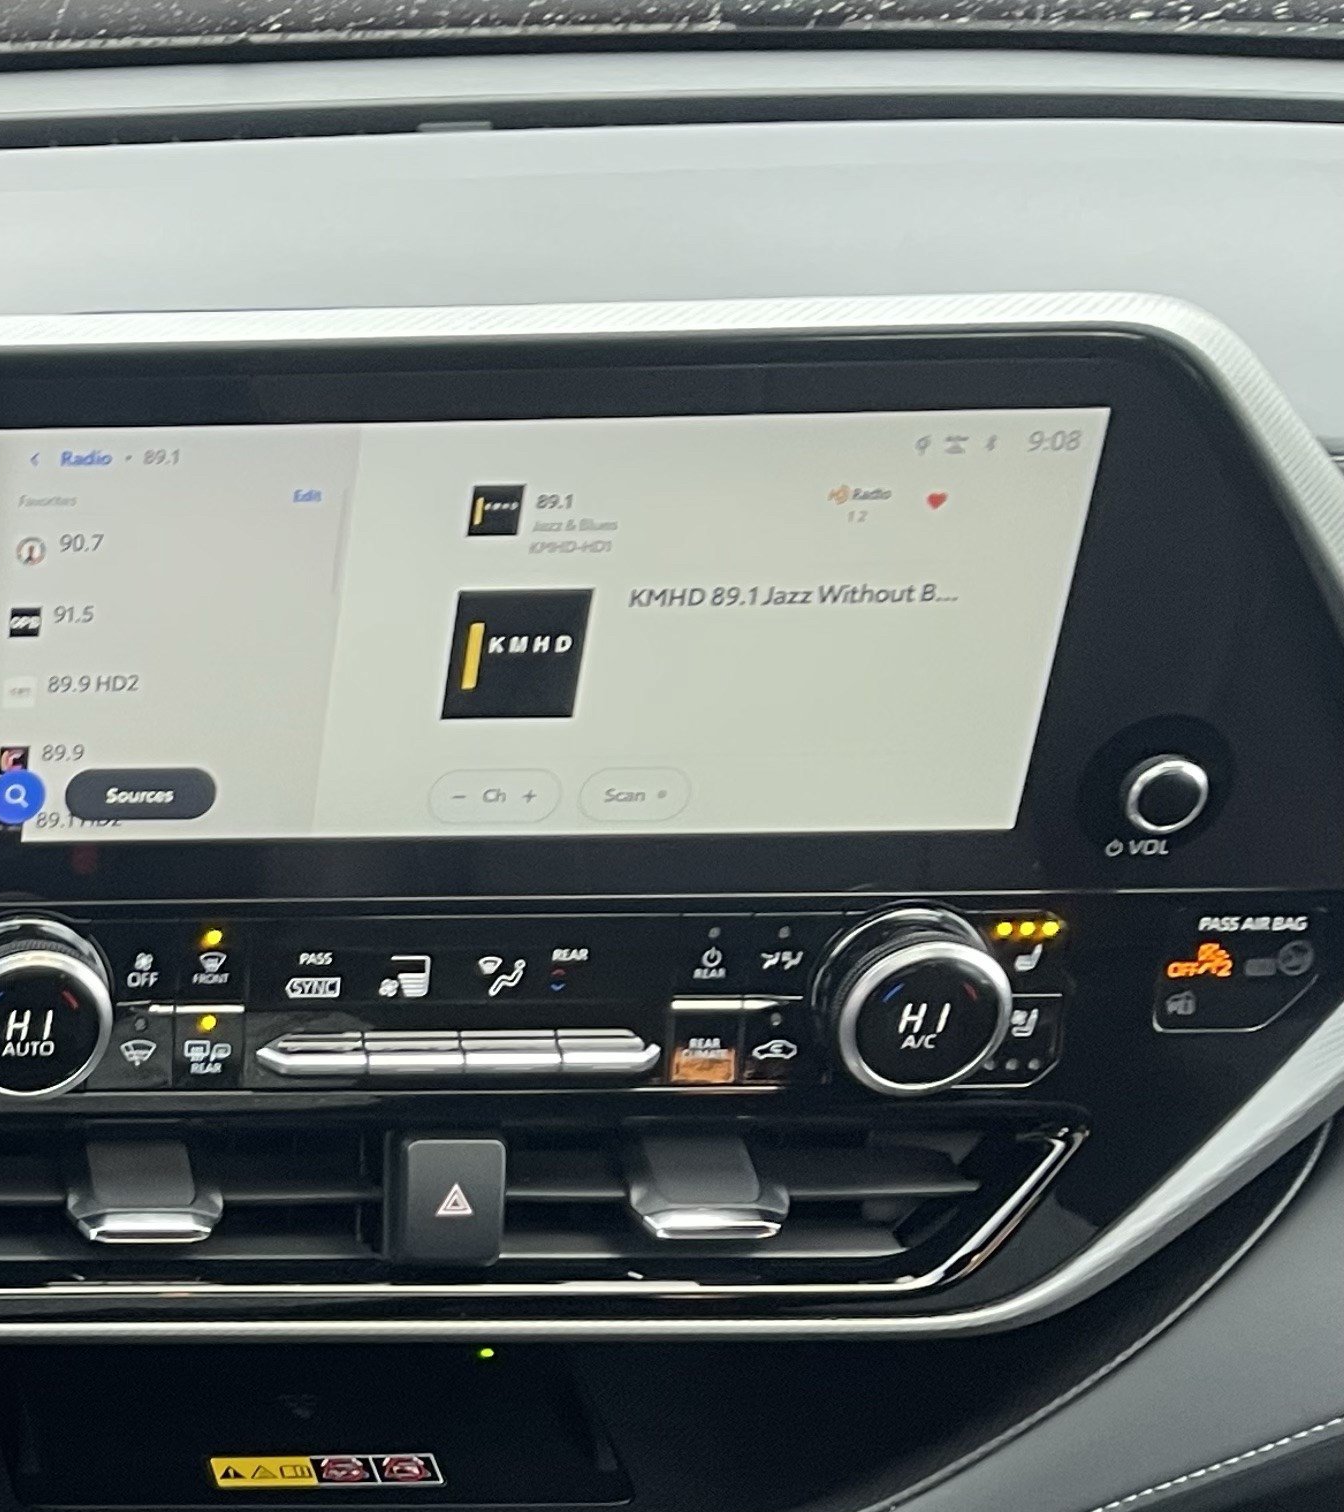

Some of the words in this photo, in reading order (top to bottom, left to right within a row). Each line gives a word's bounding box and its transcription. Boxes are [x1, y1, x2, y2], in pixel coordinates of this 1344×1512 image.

[1027, 430, 1082, 452] 9:08
[60, 451, 113, 467] Radio
[143, 449, 180, 466] 89.1
[293, 489, 322, 504] Edit
[536, 494, 573, 510] 89.1
[59, 534, 104, 553] 90.7
[629, 587, 706, 608] KMHD
[712, 586, 759, 607] 89.1
[761, 585, 813, 606] Jazz
[818, 583, 916, 605] Without
[53, 604, 95, 624] 91.5
[488, 635, 573, 654] KMHD
[47, 674, 92, 693] 89.9
[95, 674, 140, 692] HD2
[41, 743, 85, 762] 89.9
[105, 787, 174, 805] Sources
[482, 788, 507, 803] Ch
[604, 788, 646, 803] Scan
[1129, 839, 1169, 855] VOL
[1198, 916, 1241, 932] PASS
[1240, 916, 1271, 931] AIR
[1272, 916, 1308, 931] BAG
[299, 952, 333, 966] PASS
[552, 948, 589, 962] REAR
[127, 972, 159, 988] OFF
[192, 972, 229, 985] FRONT
[693, 967, 727, 980] REAR
[293, 979, 338, 996] SYNC
[5, 1009, 54, 1041] HI
[898, 1002, 952, 1034] HI
[2, 1040, 55, 1058] AUTO
[689, 1037, 721, 1049] REAR
[900, 1033, 938, 1050] A/C
[190, 1061, 223, 1074] REAR
